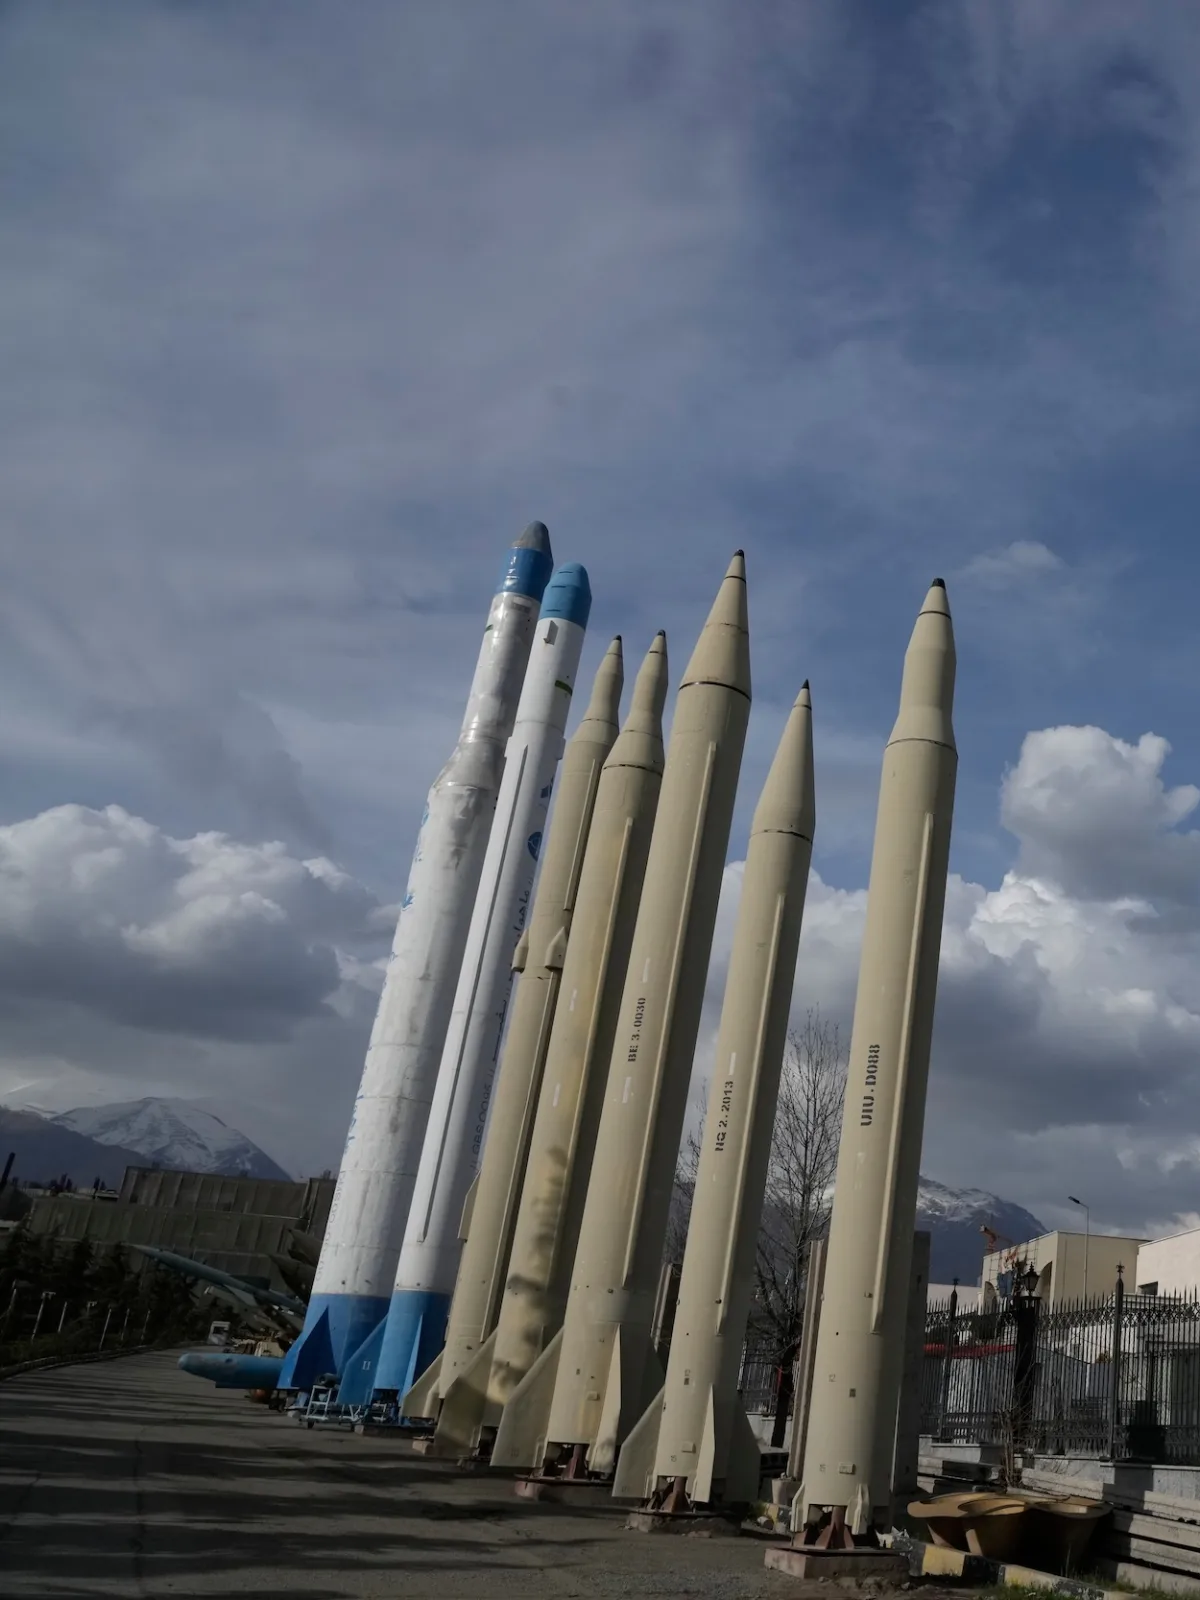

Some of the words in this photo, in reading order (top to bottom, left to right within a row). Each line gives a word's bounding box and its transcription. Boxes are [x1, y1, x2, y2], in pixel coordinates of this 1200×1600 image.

[631, 997, 646, 1041] 3.0030
[627, 1045, 639, 1062] BE
[718, 1081, 734, 1128] 2.2013
